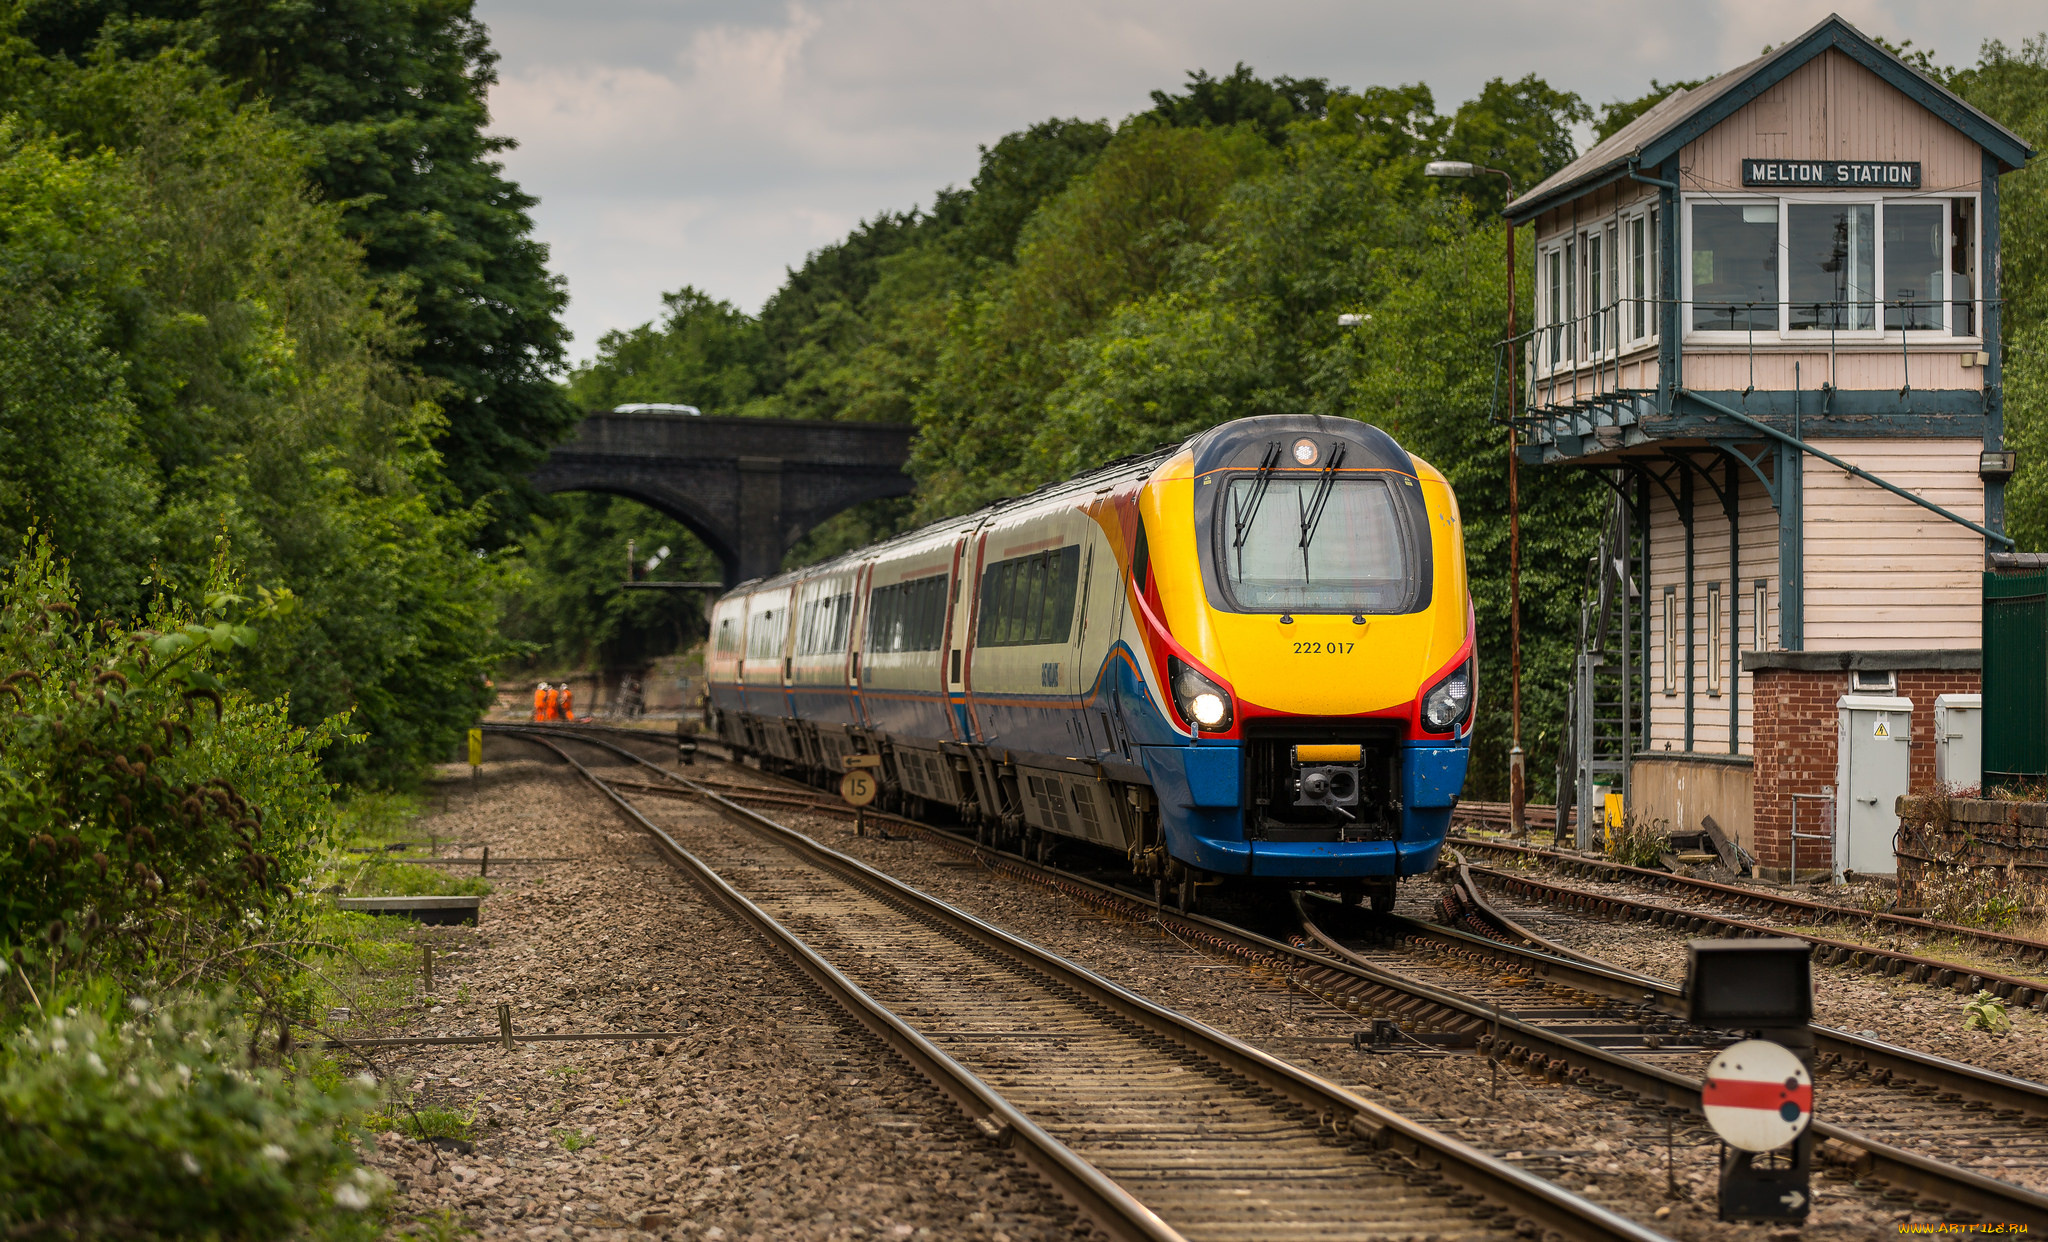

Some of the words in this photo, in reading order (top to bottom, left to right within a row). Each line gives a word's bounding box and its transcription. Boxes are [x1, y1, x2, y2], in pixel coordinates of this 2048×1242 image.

[1752, 164, 1823, 182] MELTON
[1837, 165, 1912, 183] STATION
[1293, 642, 1321, 654] 222
[1326, 642, 1355, 654] 017
[851, 779, 867, 796] 15
